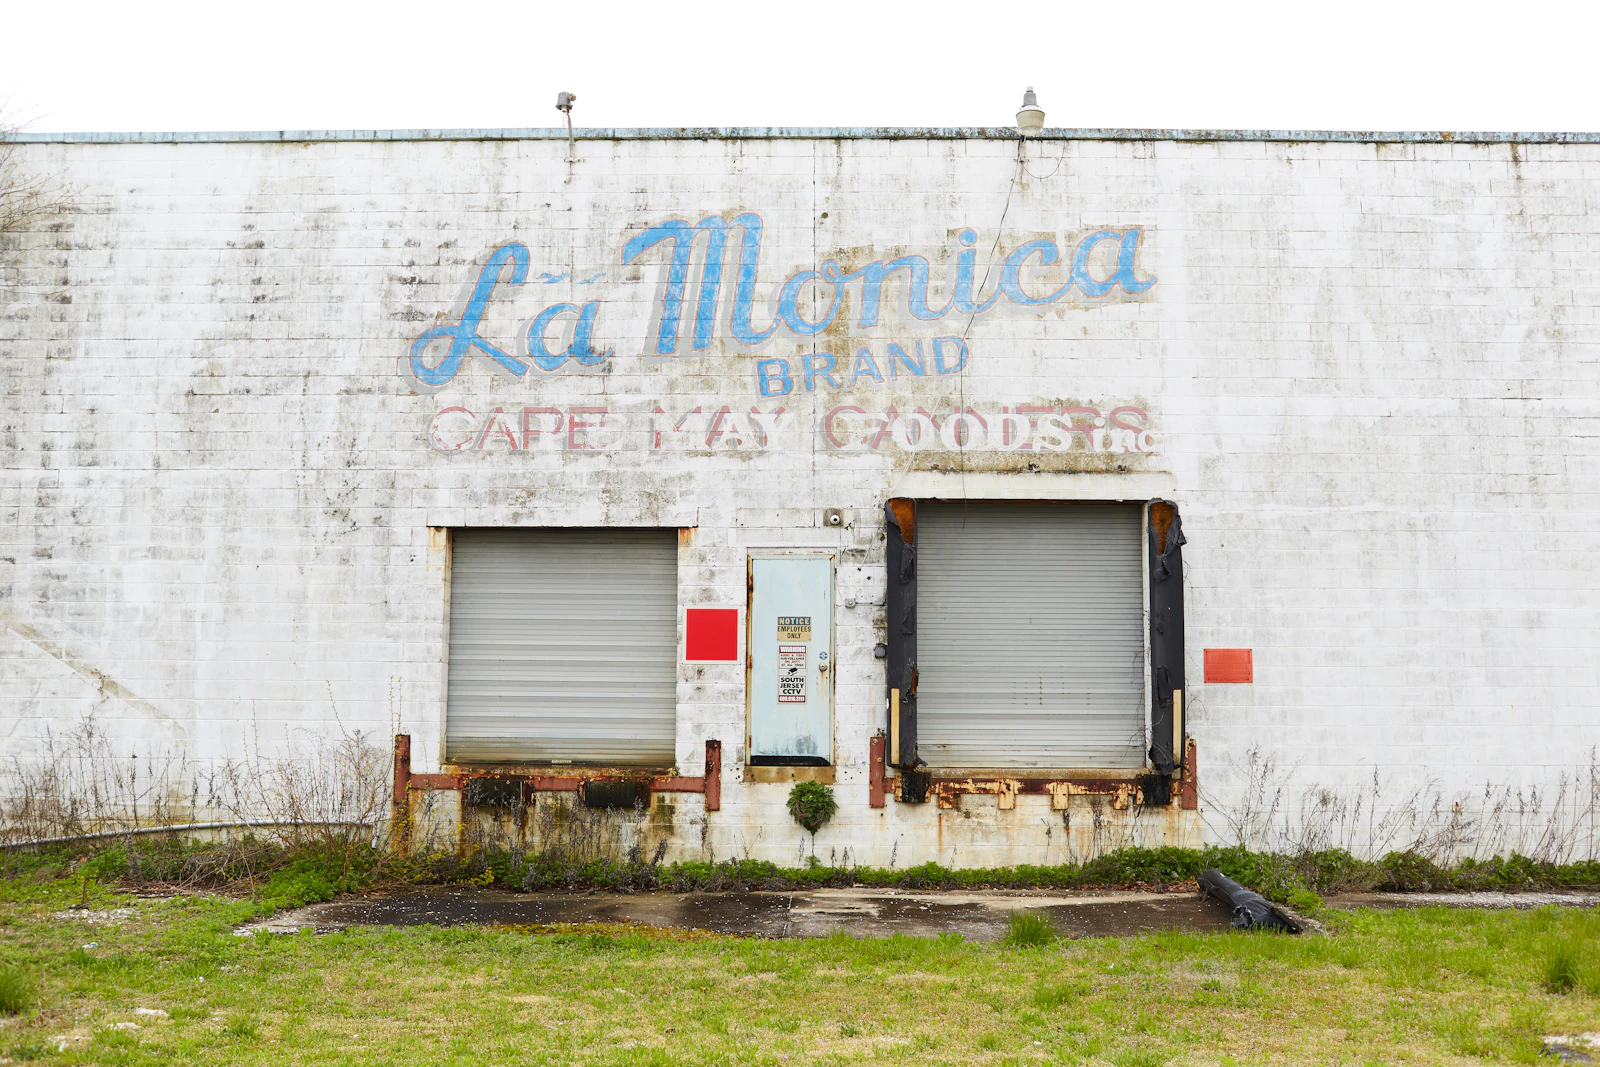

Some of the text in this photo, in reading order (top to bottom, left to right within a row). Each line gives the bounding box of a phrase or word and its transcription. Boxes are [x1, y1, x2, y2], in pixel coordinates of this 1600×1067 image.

[409, 212, 1158, 386] La Monica
[757, 335, 969, 398] BRAND
[430, 405, 613, 452] CAPE
[654, 405, 797, 452] MAY
[780, 617, 810, 625] NOTICE
[1210, 653, 1246, 661] WARNING
